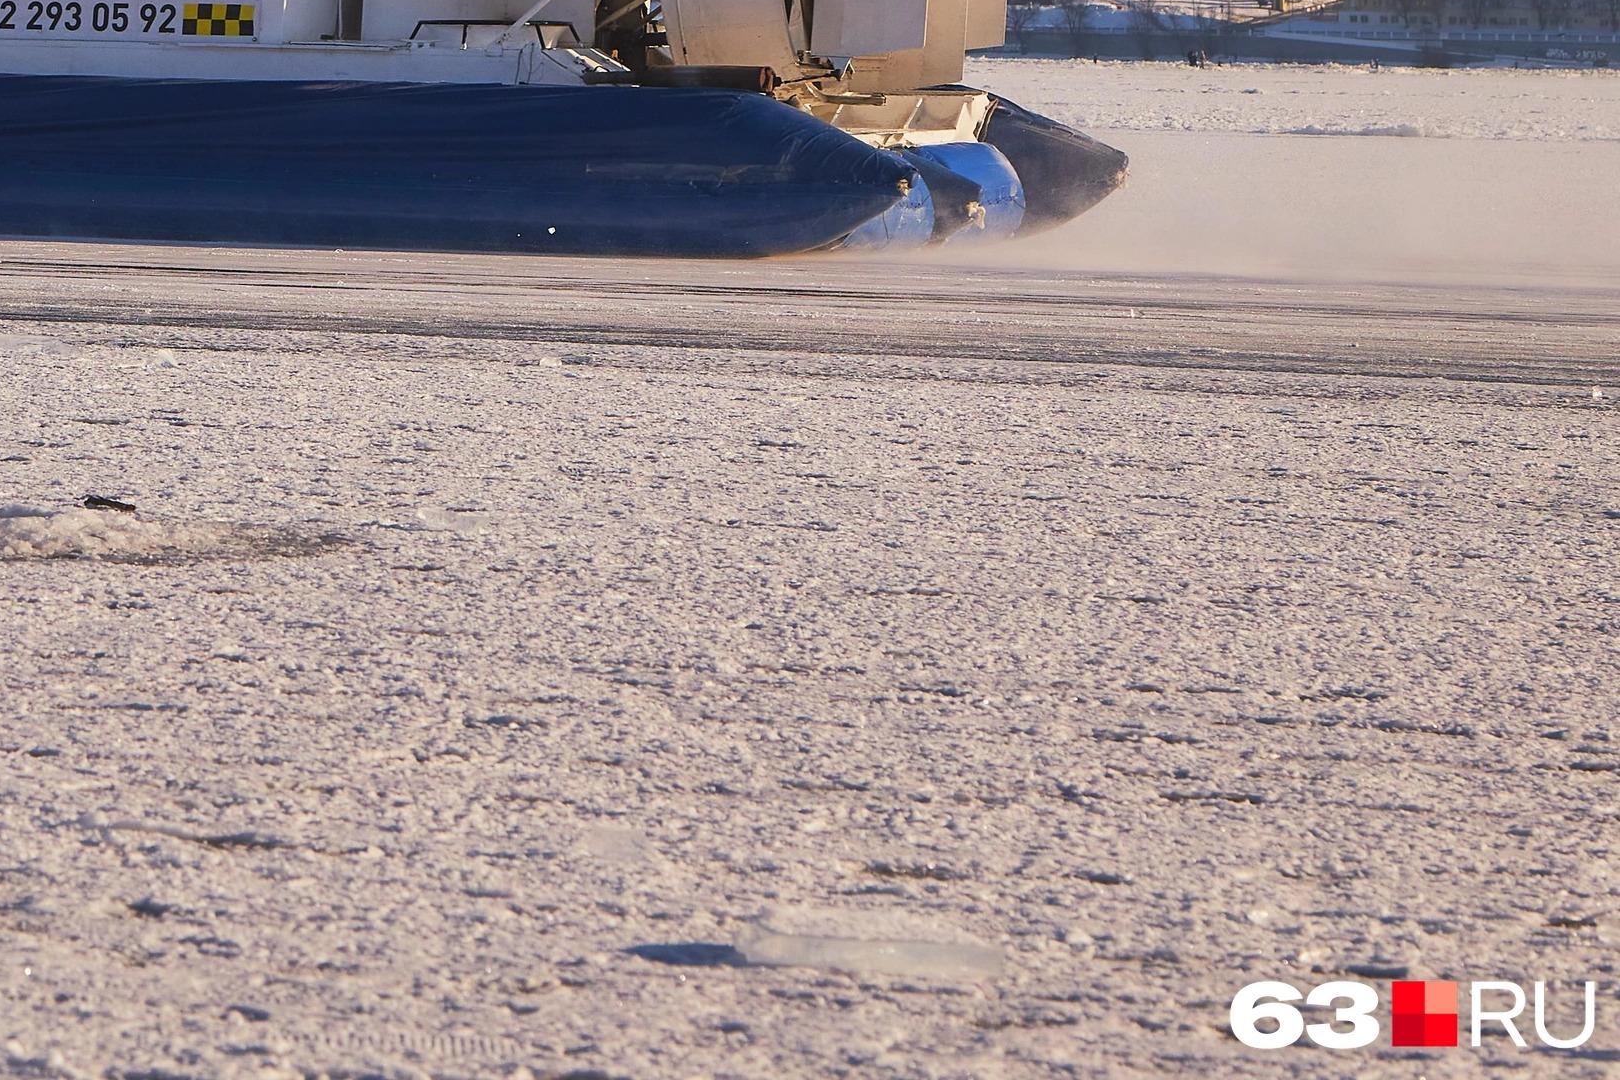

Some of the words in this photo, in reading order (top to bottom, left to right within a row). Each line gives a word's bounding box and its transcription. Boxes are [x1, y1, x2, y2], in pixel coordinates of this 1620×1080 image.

[26, 1, 82, 32] 293
[92, 2, 130, 32] 05
[139, 3, 176, 34] 92
